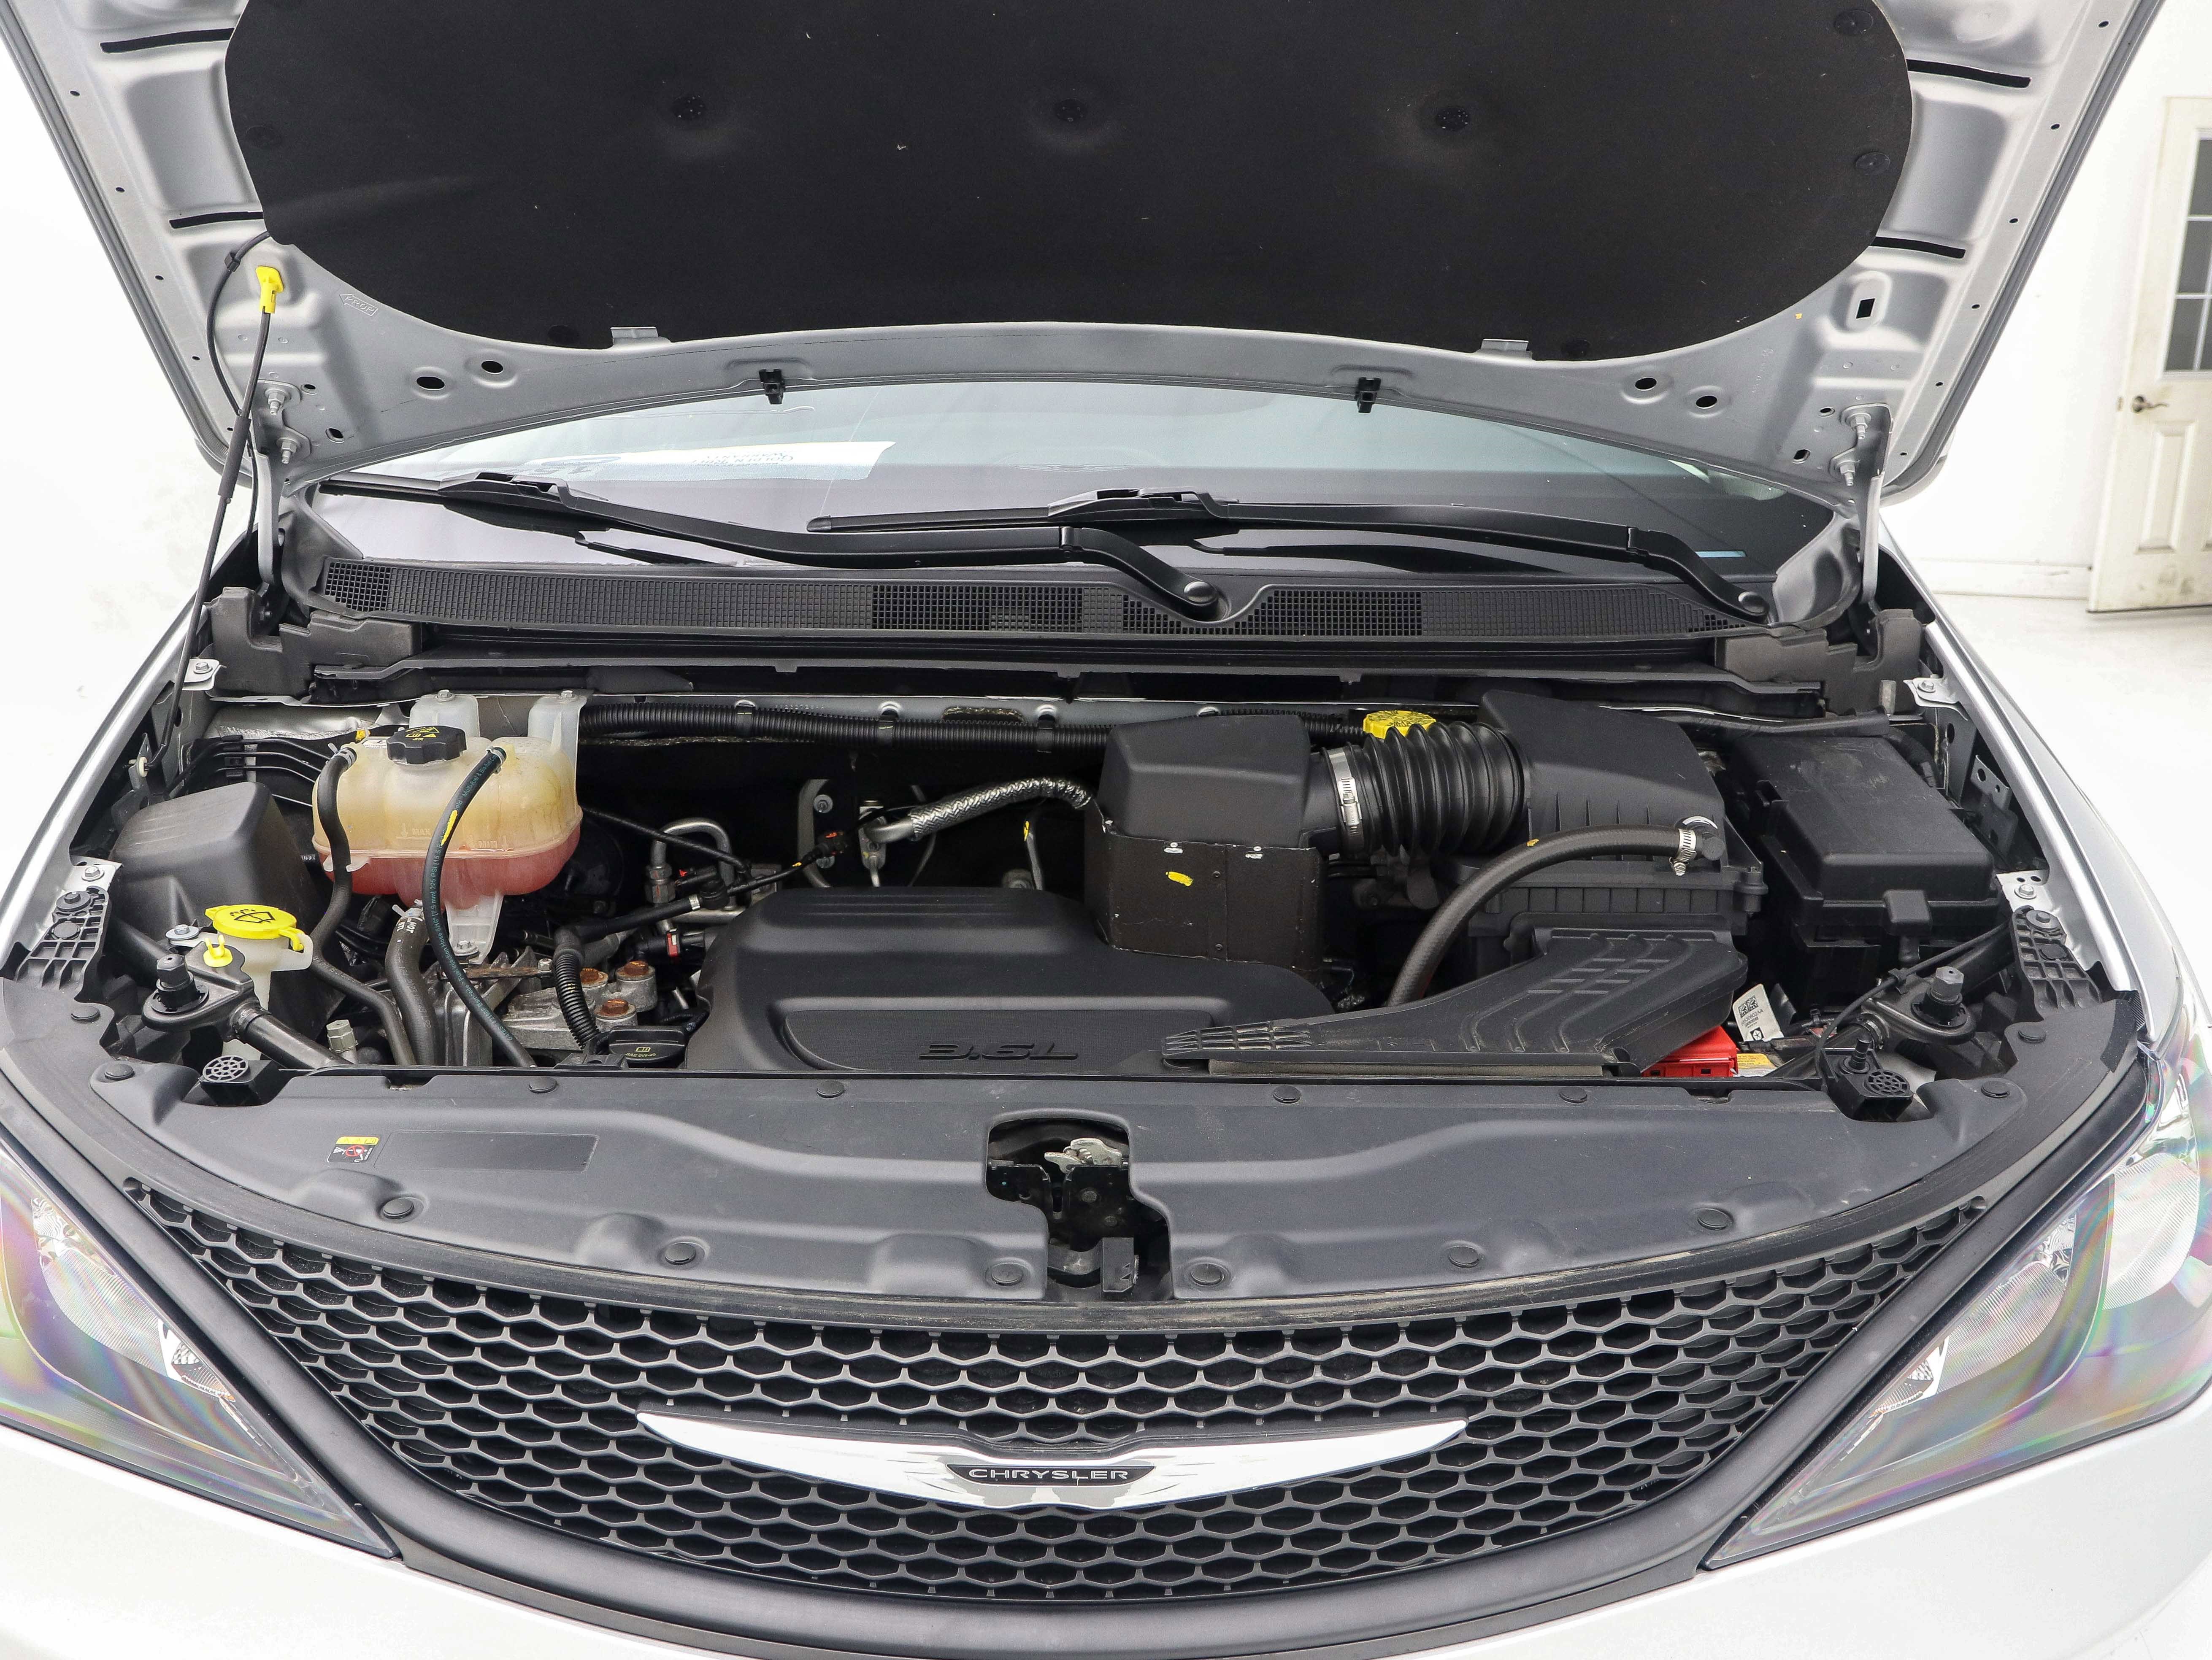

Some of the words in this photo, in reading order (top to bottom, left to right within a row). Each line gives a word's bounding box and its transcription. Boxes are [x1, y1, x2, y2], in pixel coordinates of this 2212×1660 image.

[344, 297, 374, 311] PROP
[919, 1042, 1079, 1060] 3.6L
[968, 1469, 1128, 1479] CHRYSLER
